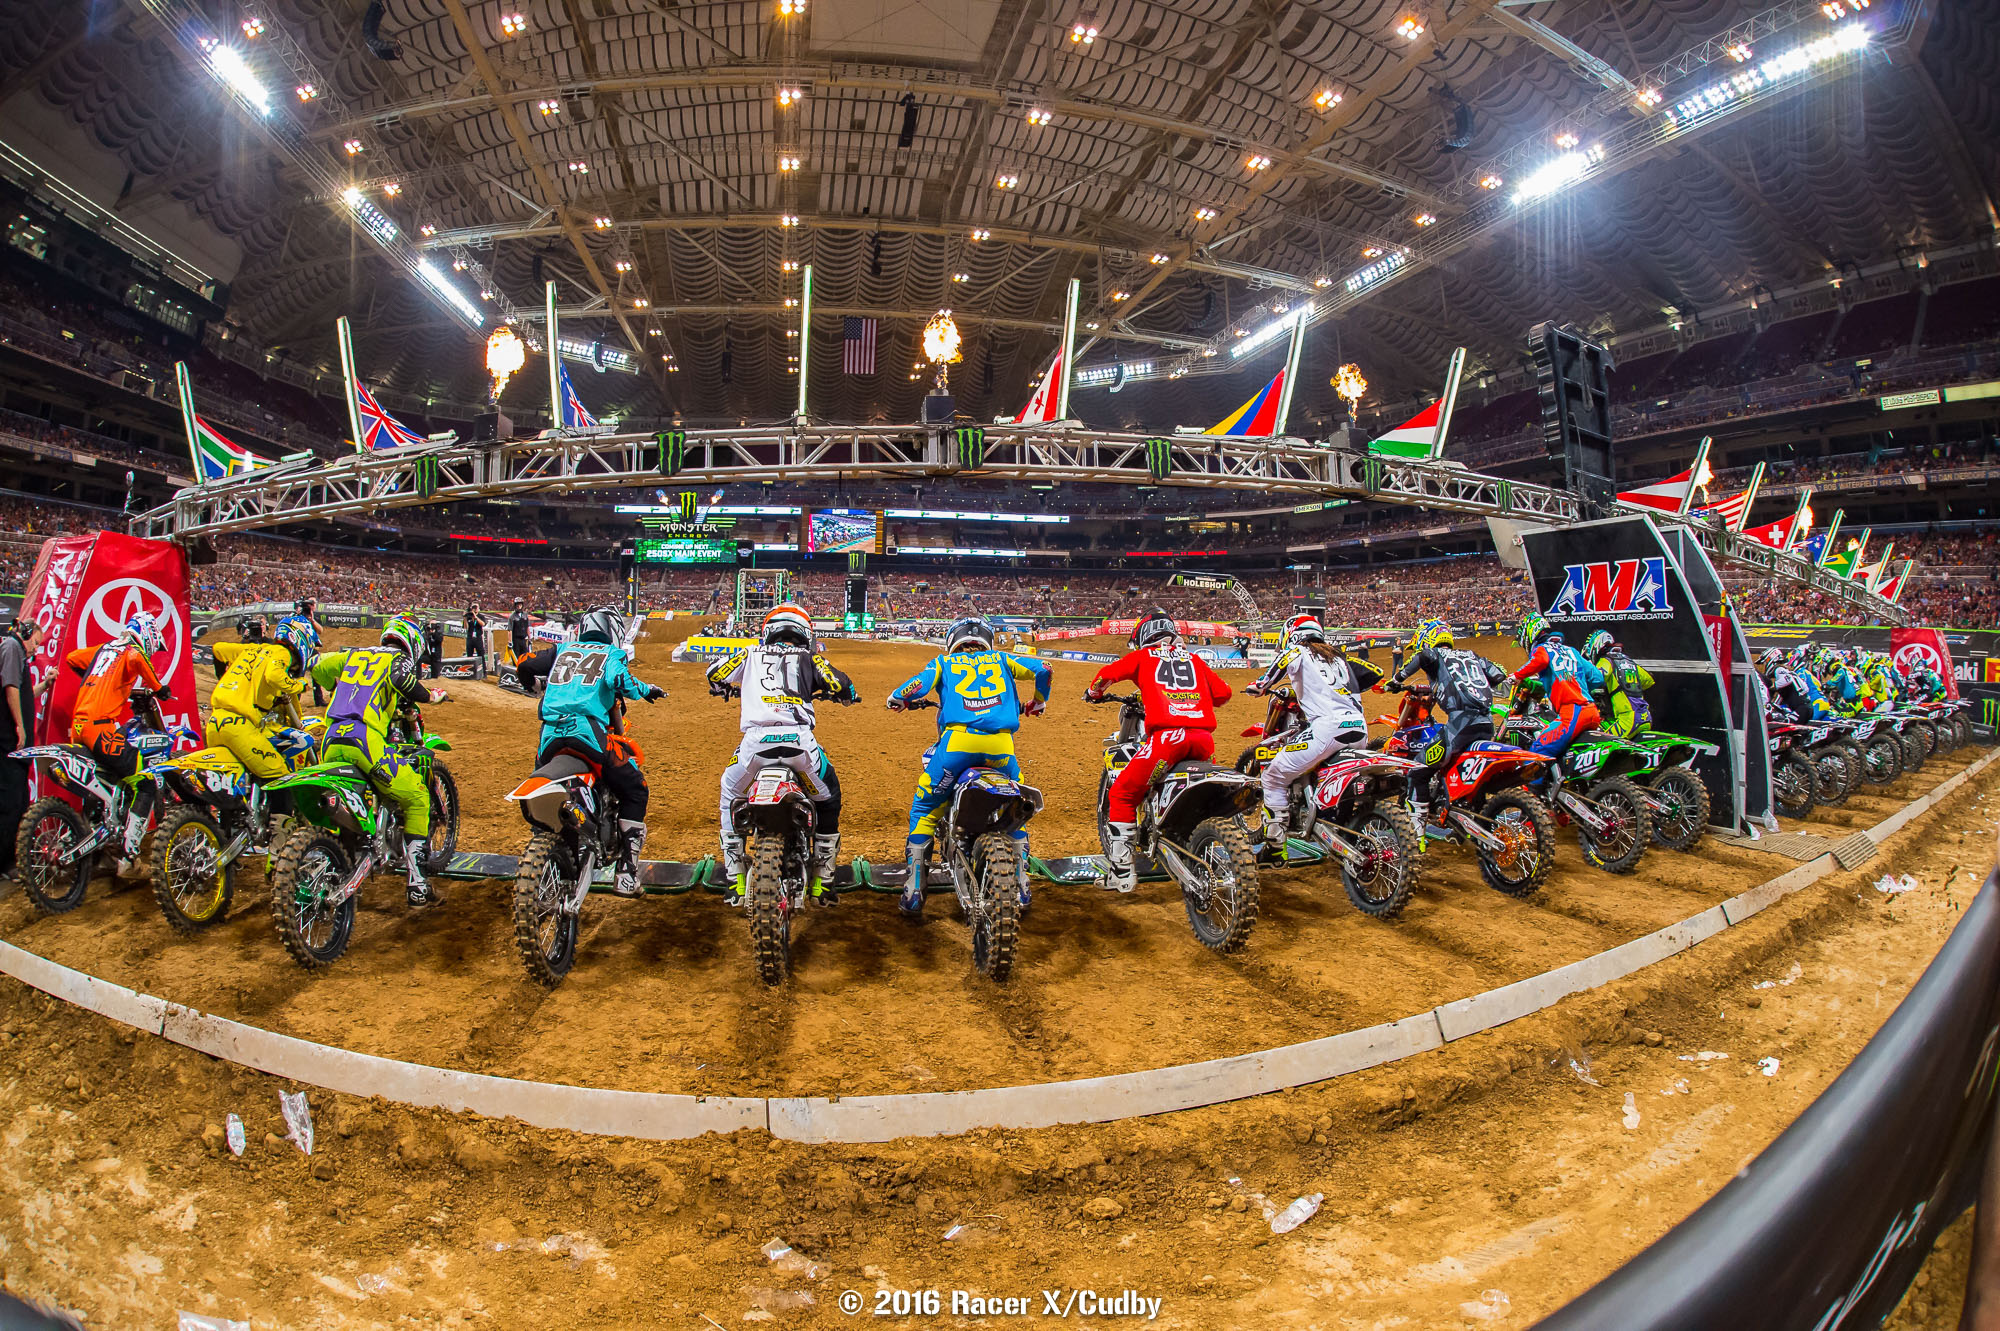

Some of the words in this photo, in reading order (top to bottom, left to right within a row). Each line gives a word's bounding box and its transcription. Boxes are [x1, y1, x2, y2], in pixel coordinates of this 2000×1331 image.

[1295, 503, 1322, 513] EMERSON
[660, 523, 718, 533] MONSTER
[675, 550, 695, 558] MAIN
[1184, 579, 1227, 590] HOLESHOT
[1544, 557, 1674, 617] AMA
[328, 616, 359, 624] MONSTER
[1577, 614, 1628, 622] MOTORCYCLIST
[1628, 612, 1674, 621] ASSOCIATION
[47, 623, 62, 658] Go
[537, 630, 563, 642] PARTS
[340, 650, 394, 687] 53
[549, 650, 609, 687] 64
[710, 647, 749, 683] GEICO
[760, 653, 801, 694] 31
[1155, 658, 1198, 690] 49
[1444, 656, 1489, 689] 30
[1954, 661, 1979, 681] aki
[951, 663, 1007, 699] 23
[761, 694, 804, 705] GEICO
[963, 696, 1001, 709] YAMALUBE
[1160, 727, 1186, 745] FLY
[1286, 742, 1308, 752] GEICO
[1461, 756, 1487, 782] 30
[1574, 749, 1601, 771] 201
[205, 770, 236, 795] 84
